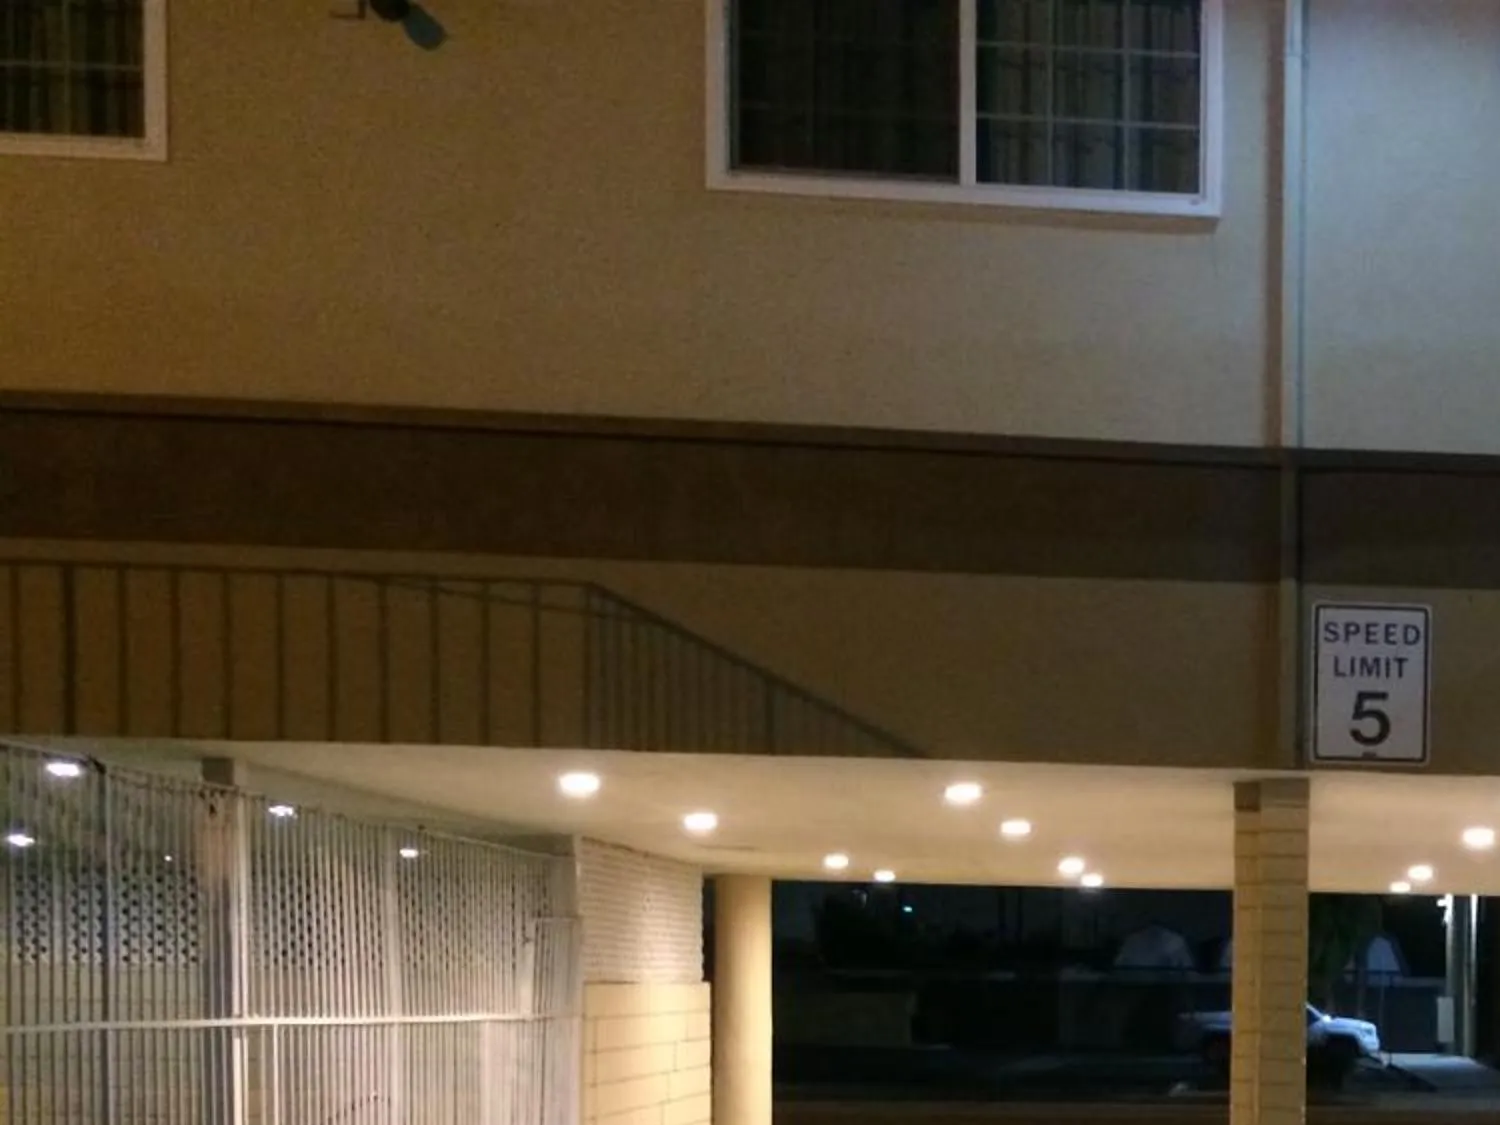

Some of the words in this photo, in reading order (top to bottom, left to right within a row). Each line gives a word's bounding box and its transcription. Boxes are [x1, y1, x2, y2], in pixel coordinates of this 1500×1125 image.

[1323, 621, 1421, 646] SPEED
[1333, 655, 1409, 679] LIMIT
[1350, 690, 1391, 747] 5
